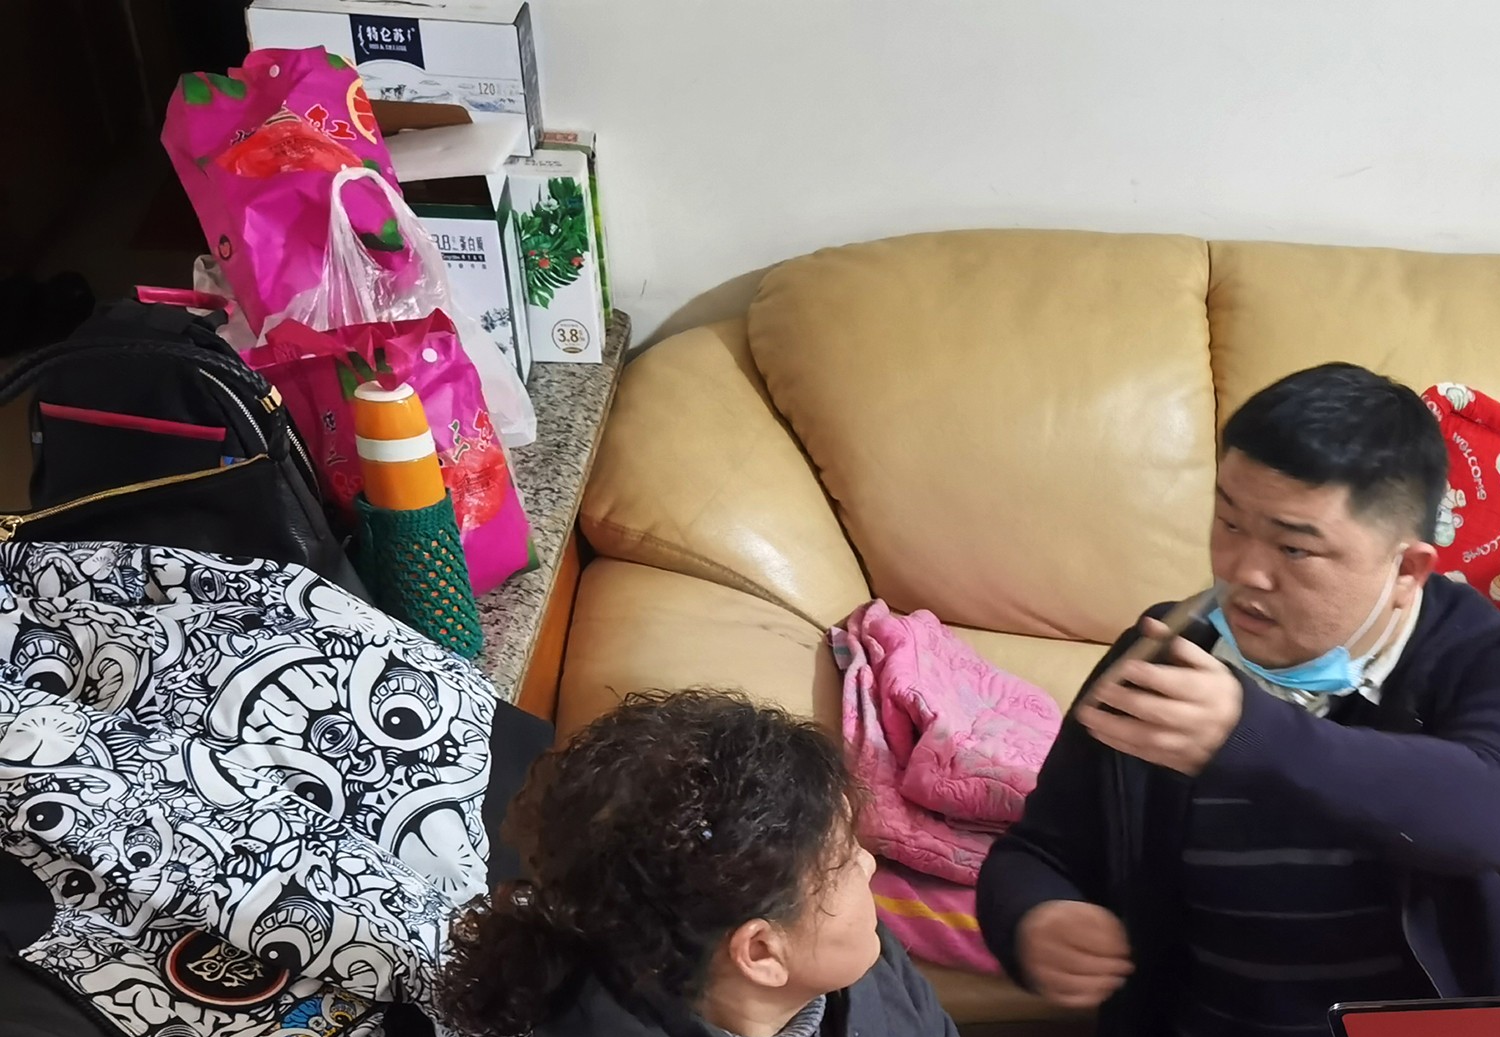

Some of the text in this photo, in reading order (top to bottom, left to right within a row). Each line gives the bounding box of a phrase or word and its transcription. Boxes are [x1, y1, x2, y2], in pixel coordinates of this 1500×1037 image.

[366, 26, 405, 43] 特仑苏
[478, 82, 496, 96] 120
[557, 328, 579, 343] 3.8
